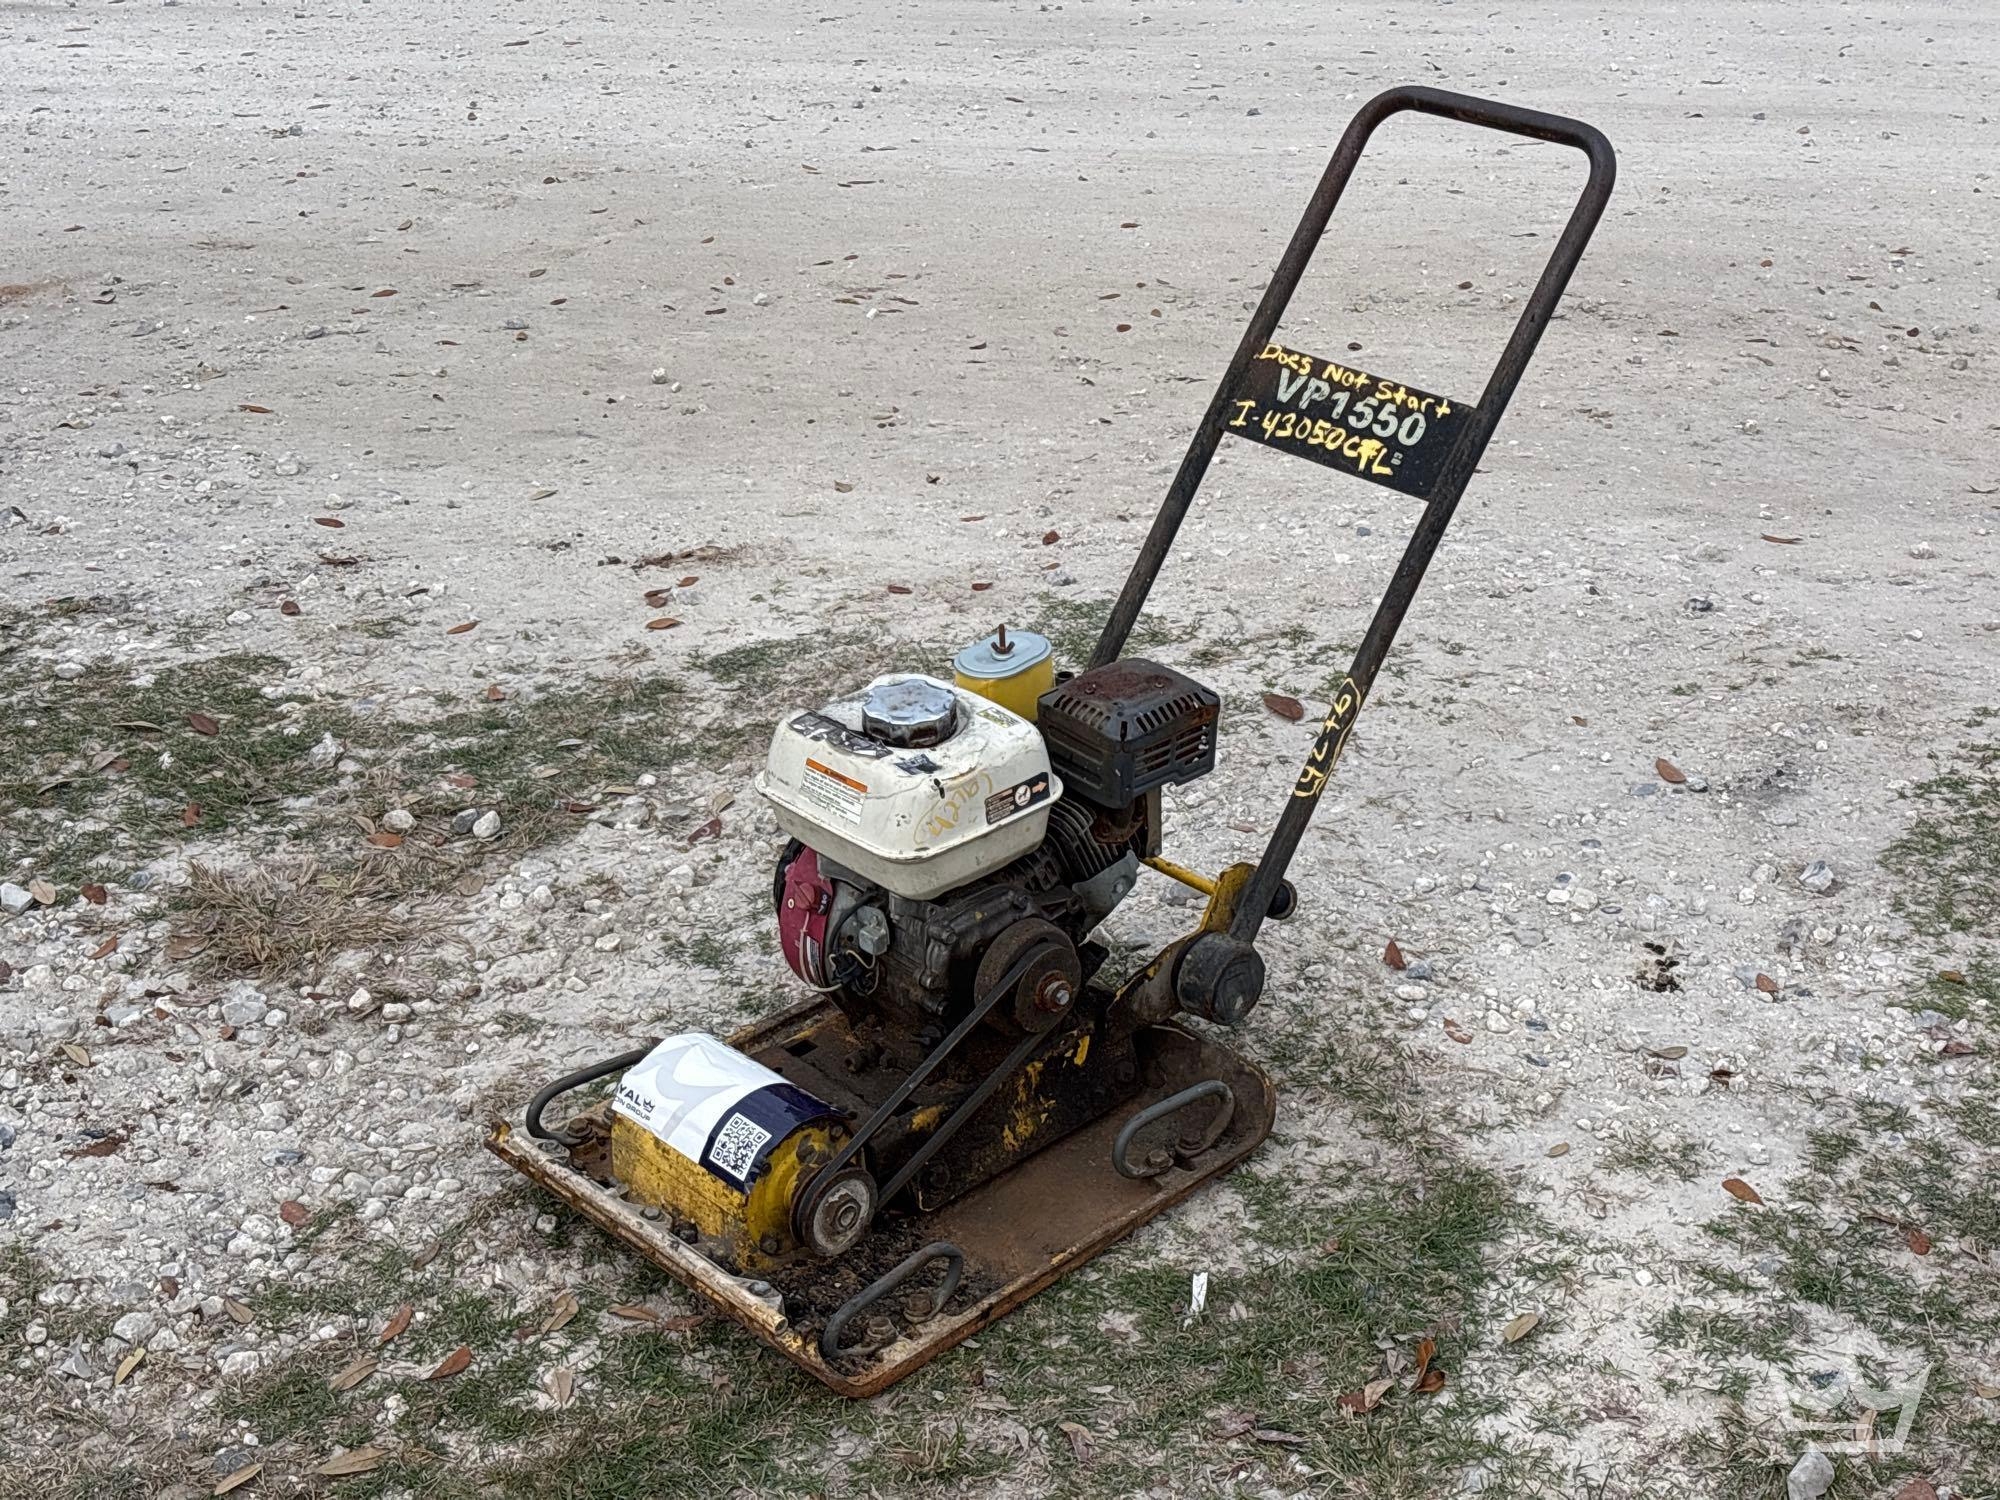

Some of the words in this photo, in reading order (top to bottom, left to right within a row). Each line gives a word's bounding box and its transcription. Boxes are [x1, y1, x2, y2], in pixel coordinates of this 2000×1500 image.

[1259, 343, 1314, 376] Does
[1321, 364, 1371, 391] Not
[1375, 381, 1451, 418] Start
[1276, 368, 1426, 447] VP1550
[616, 1083, 645, 1106] YAL
[625, 1102, 651, 1121] GROUP
